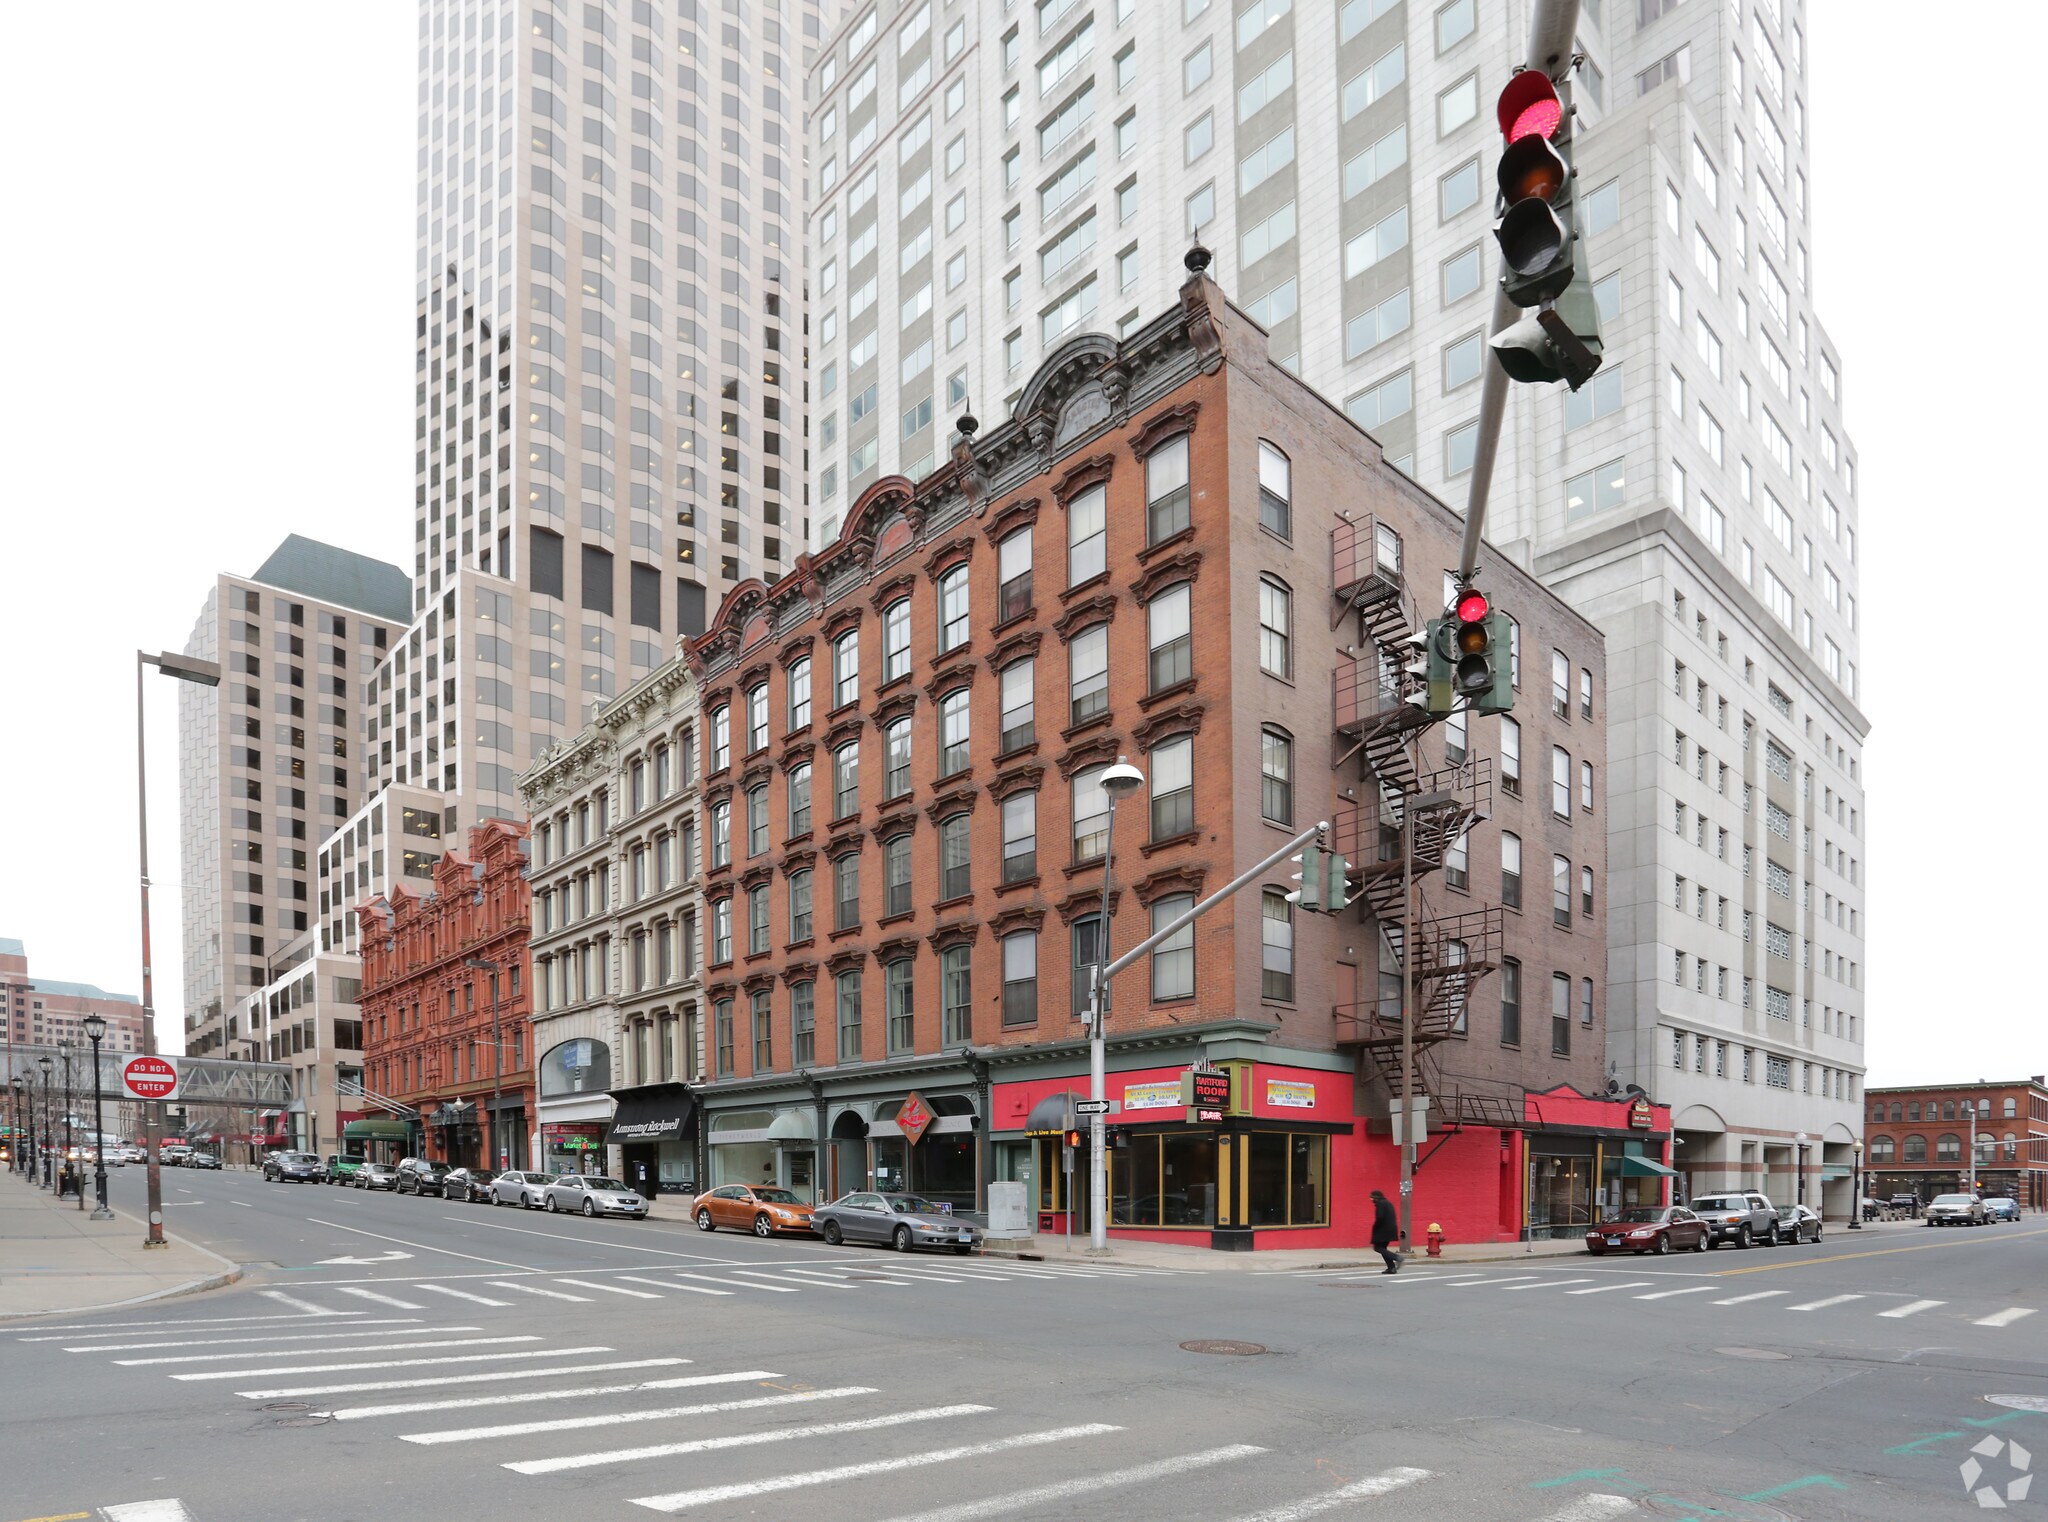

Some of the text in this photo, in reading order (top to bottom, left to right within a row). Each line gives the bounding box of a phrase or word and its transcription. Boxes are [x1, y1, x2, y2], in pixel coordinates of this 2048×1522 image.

[137, 1083, 165, 1091] ENTER
[1196, 1077, 1228, 1087] HARTFORD
[1197, 1086, 1228, 1097] ROOM
[613, 1123, 649, 1134] Armstrong
[647, 1118, 680, 1132] Rockwell
